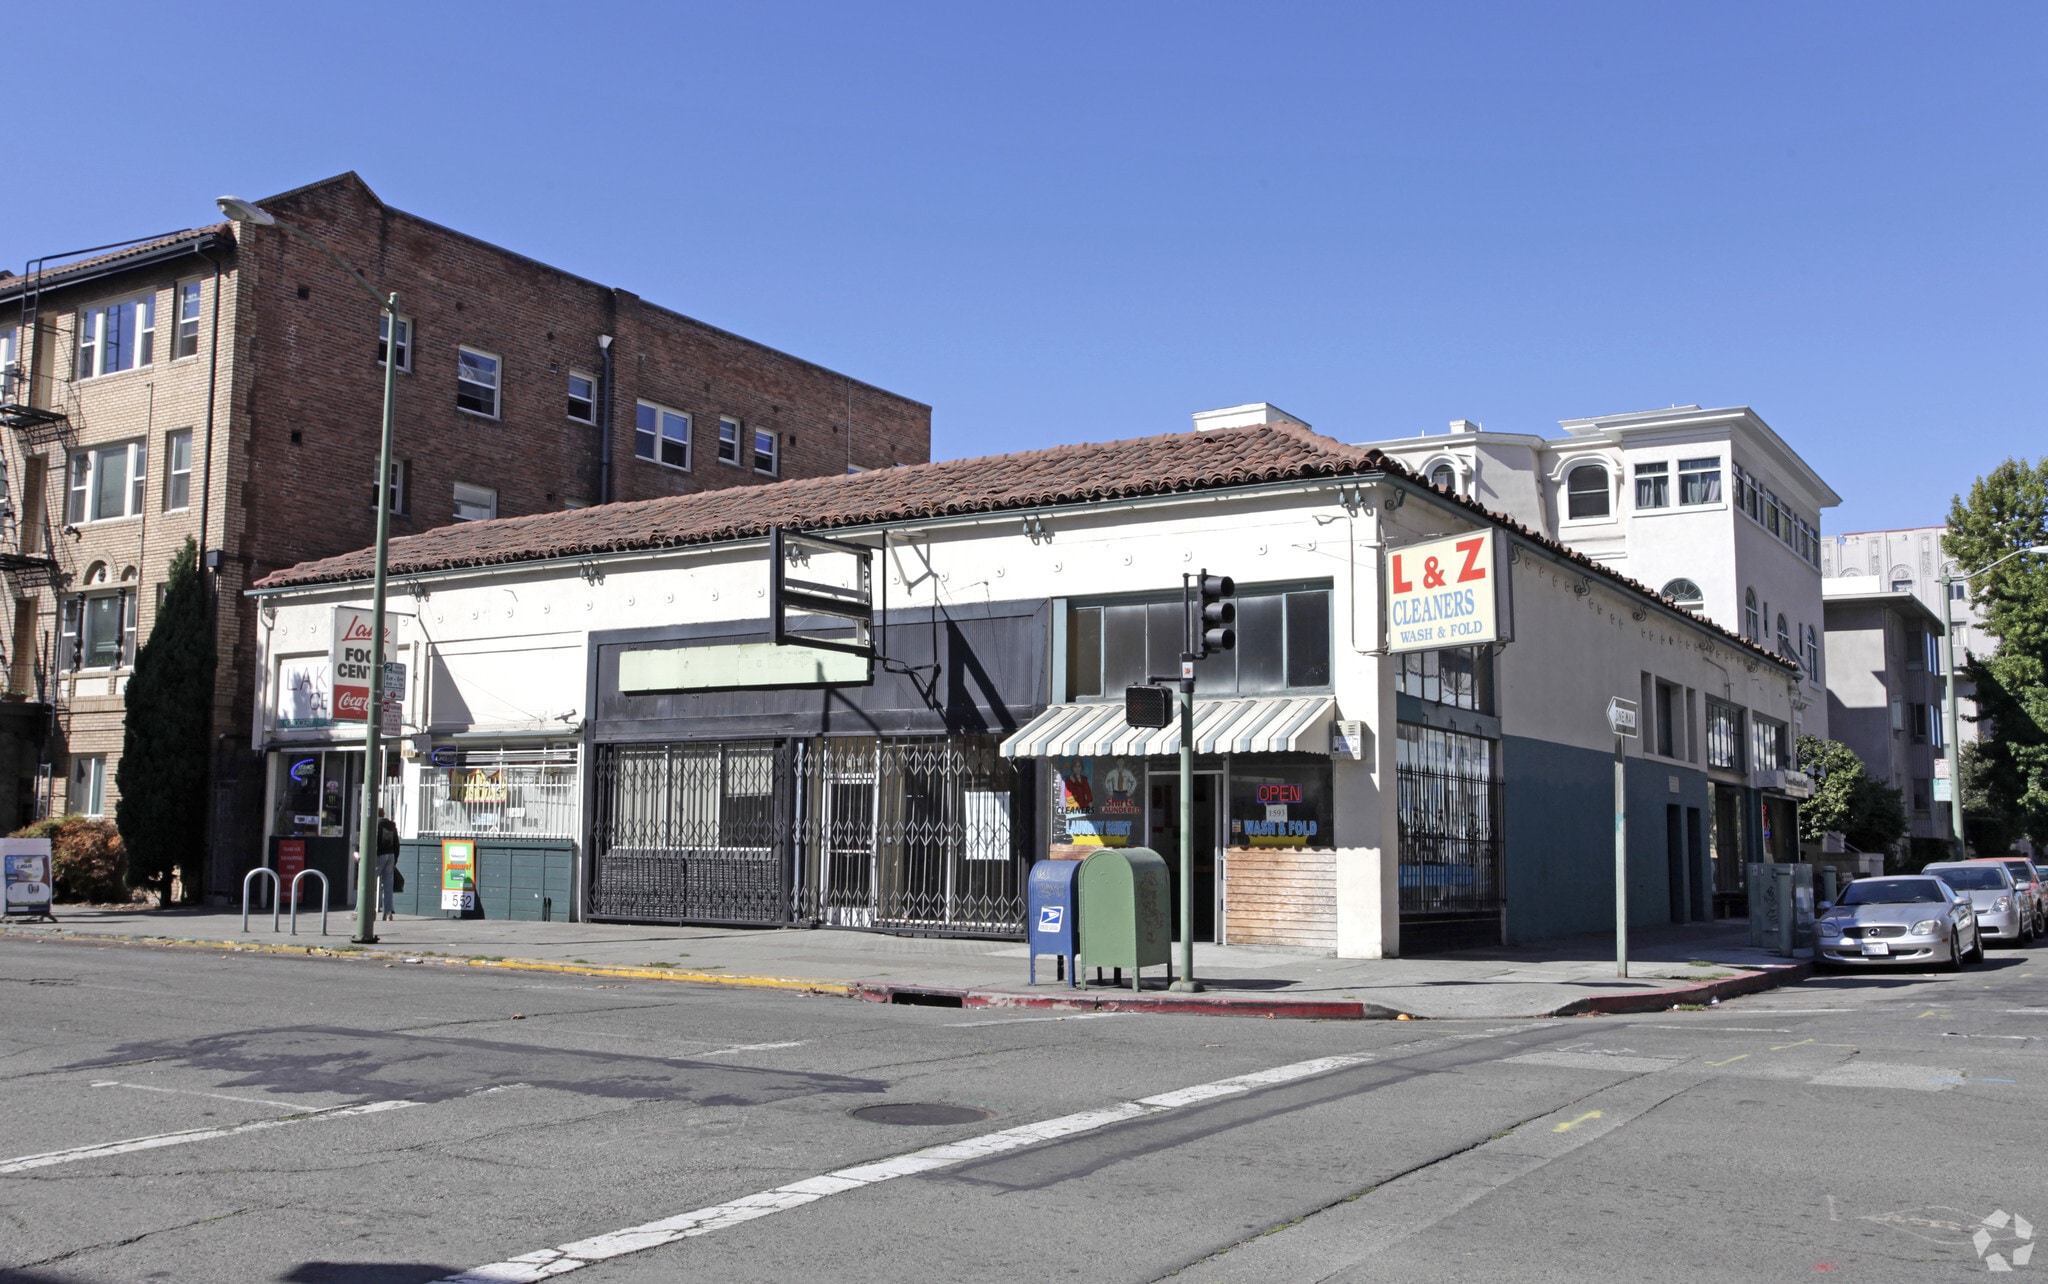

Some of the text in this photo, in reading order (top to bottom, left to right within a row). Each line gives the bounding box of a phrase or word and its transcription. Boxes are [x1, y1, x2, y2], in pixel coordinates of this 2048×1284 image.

[1392, 536, 1486, 595] L & Z
[1392, 588, 1475, 627] CLEANERS
[341, 615, 391, 643] Lae
[1400, 620, 1483, 643] WASH & FOLD
[286, 665, 328, 691] LAK
[1616, 709, 1635, 726] ONE WAY
[1259, 785, 1300, 801] OPEN
[1057, 806, 1095, 815] CLEANERS
[1100, 807, 1141, 815] LAUNDERED
[1106, 799, 1134, 807] Shirts
[1269, 809, 1285, 817] 1593
[1105, 820, 1132, 835] SHIRT
[1244, 820, 1318, 836] WASH & FOLD
